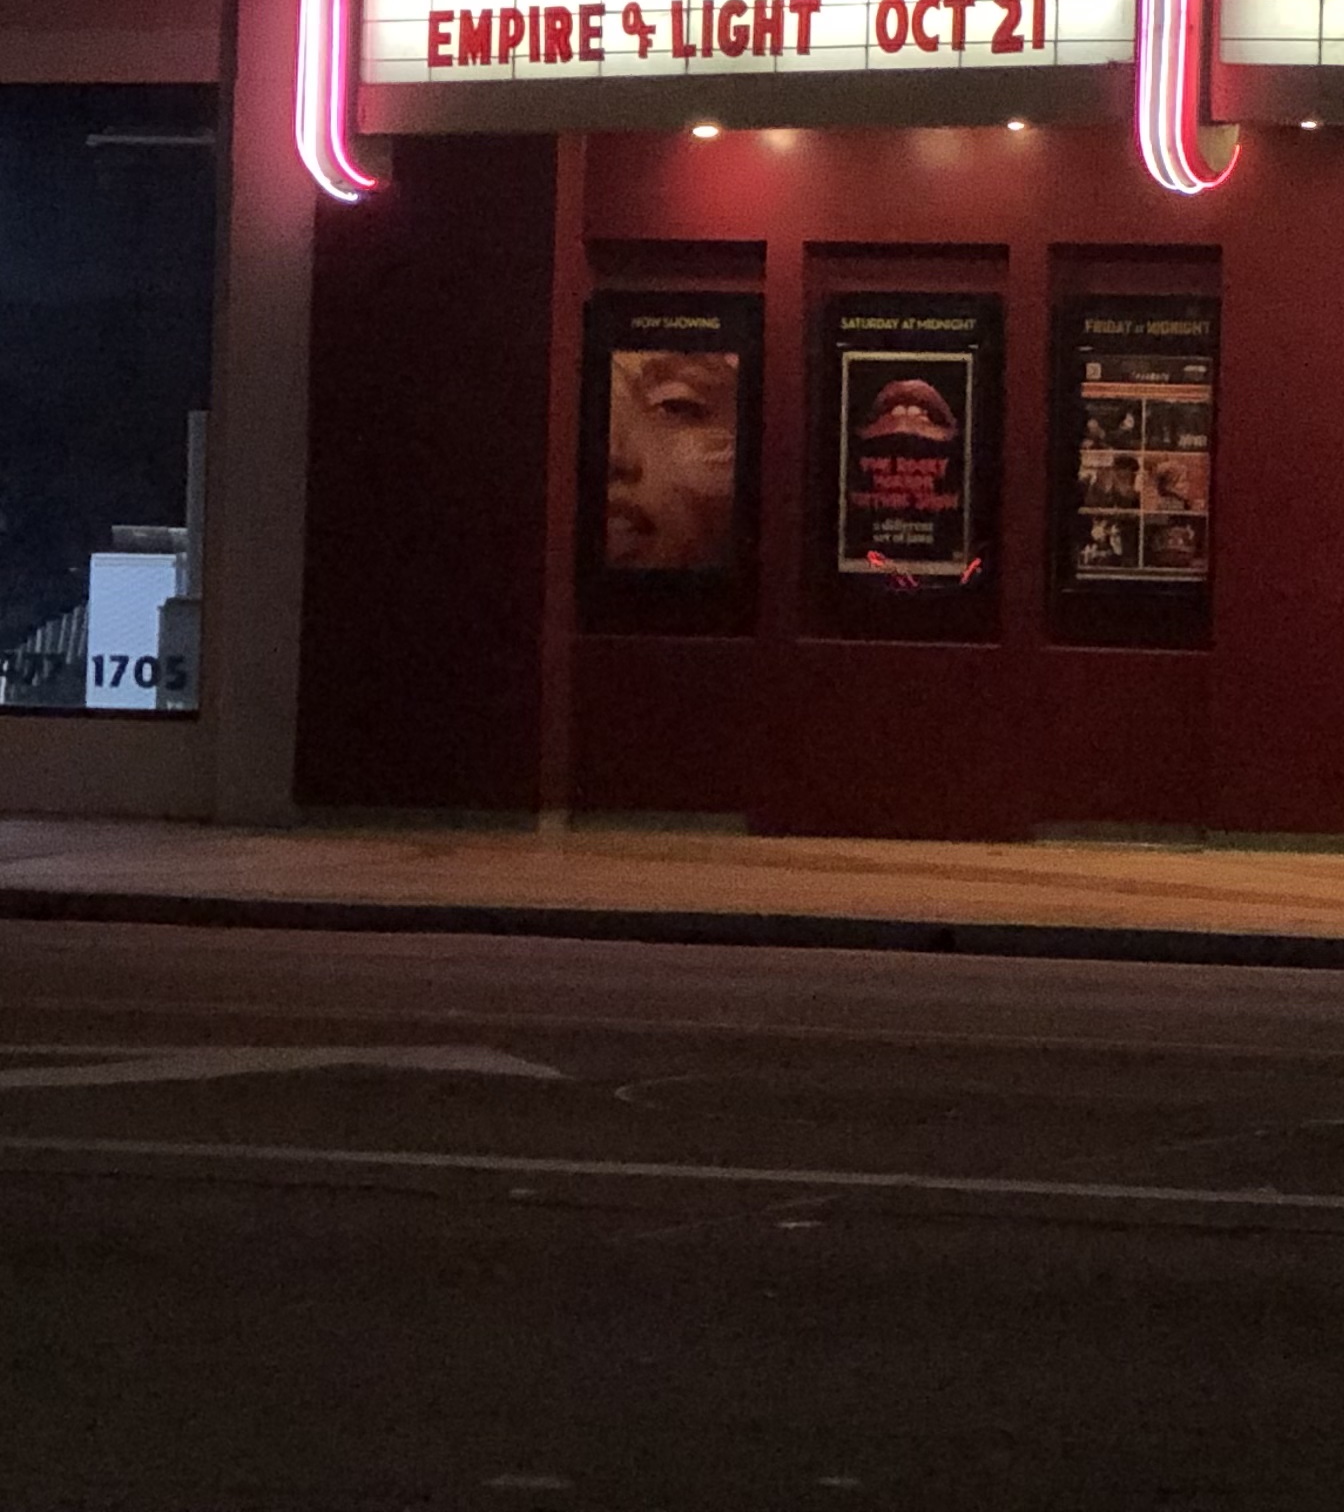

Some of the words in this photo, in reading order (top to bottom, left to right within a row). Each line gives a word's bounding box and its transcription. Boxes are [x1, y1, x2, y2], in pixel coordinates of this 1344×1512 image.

[427, 3, 606, 67] EMPIRE
[840, 316, 900, 331] SATURDAY
[901, 316, 916, 331] AT
[917, 317, 977, 331] MIDNIGHT
[1084, 318, 1133, 335] FRIDAY
[1146, 319, 1211, 336] MIDNIGHT
[92, 654, 188, 691] 1705
